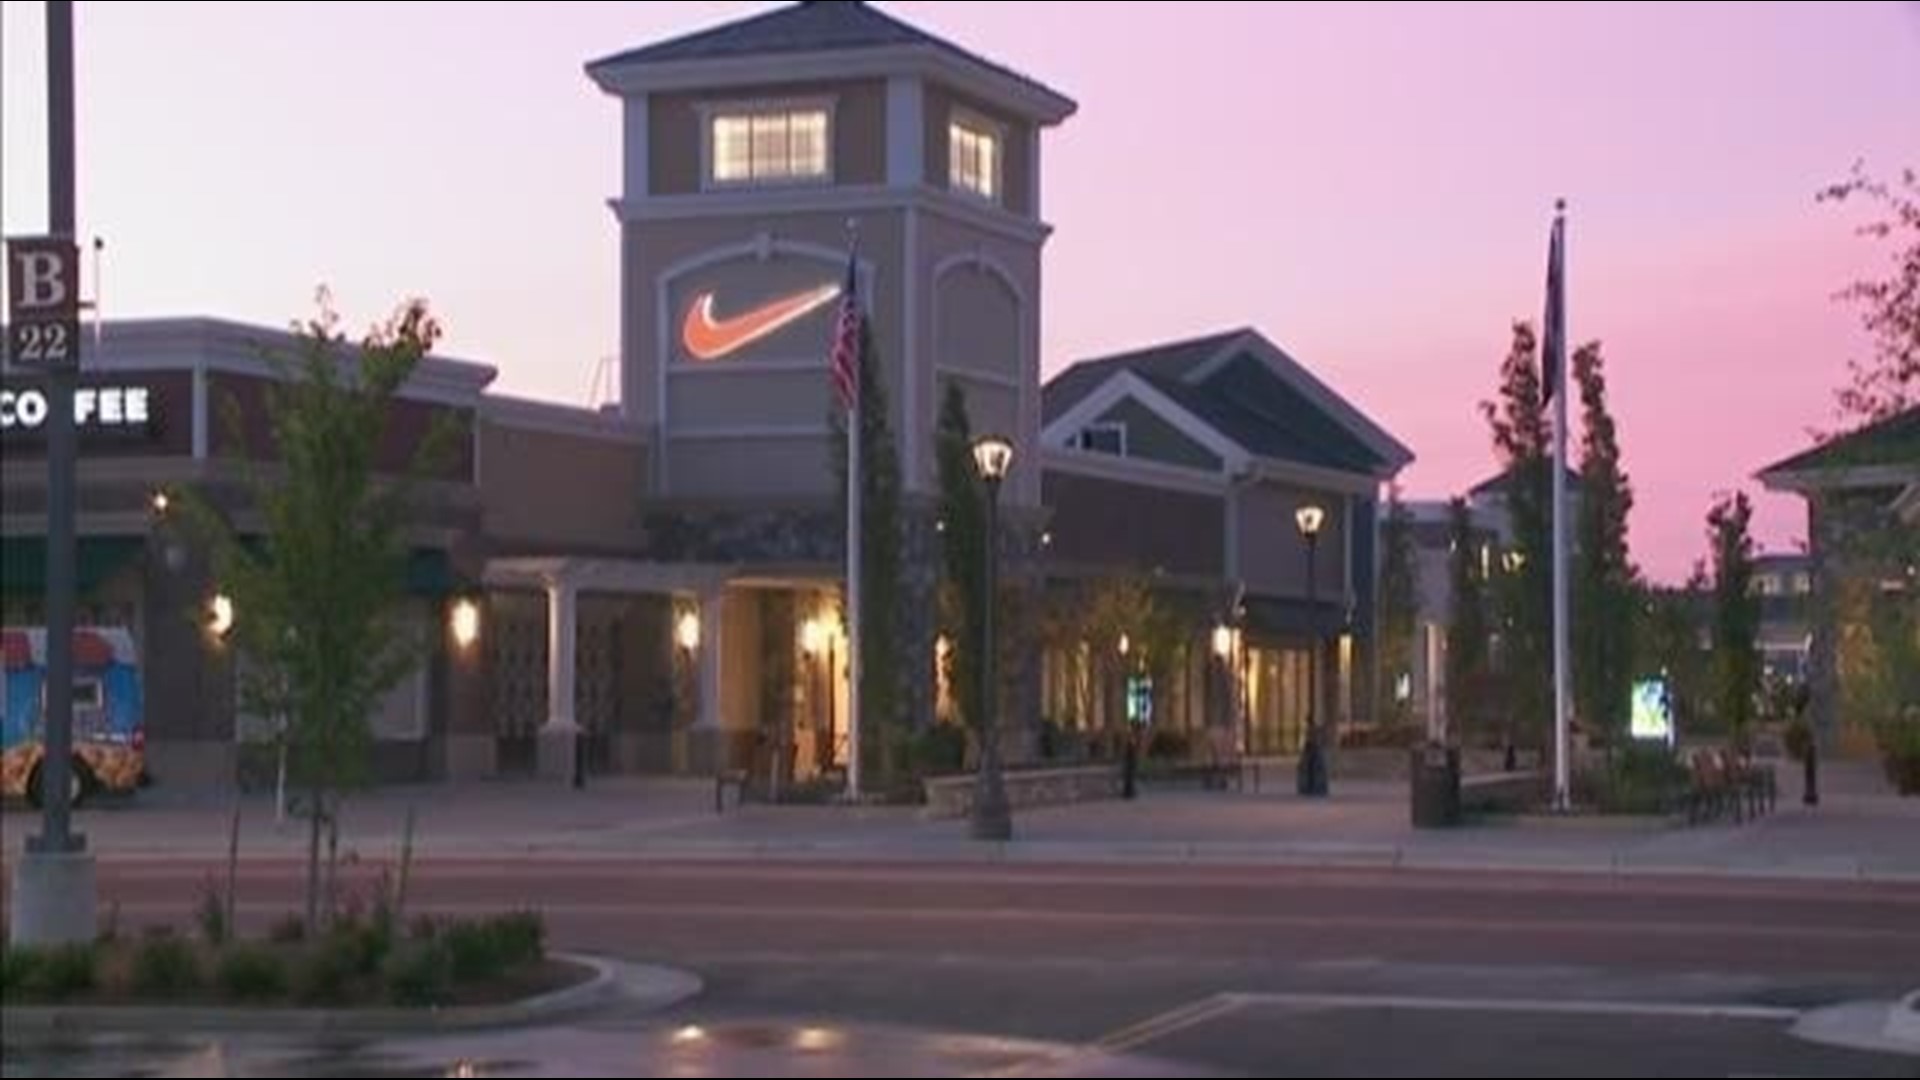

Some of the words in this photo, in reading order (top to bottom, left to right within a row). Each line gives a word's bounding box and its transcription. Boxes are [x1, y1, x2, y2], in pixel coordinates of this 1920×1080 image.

[16, 252, 66, 308] B
[19, 324, 67, 360] 22
[0, 387, 149, 427] COFEE
